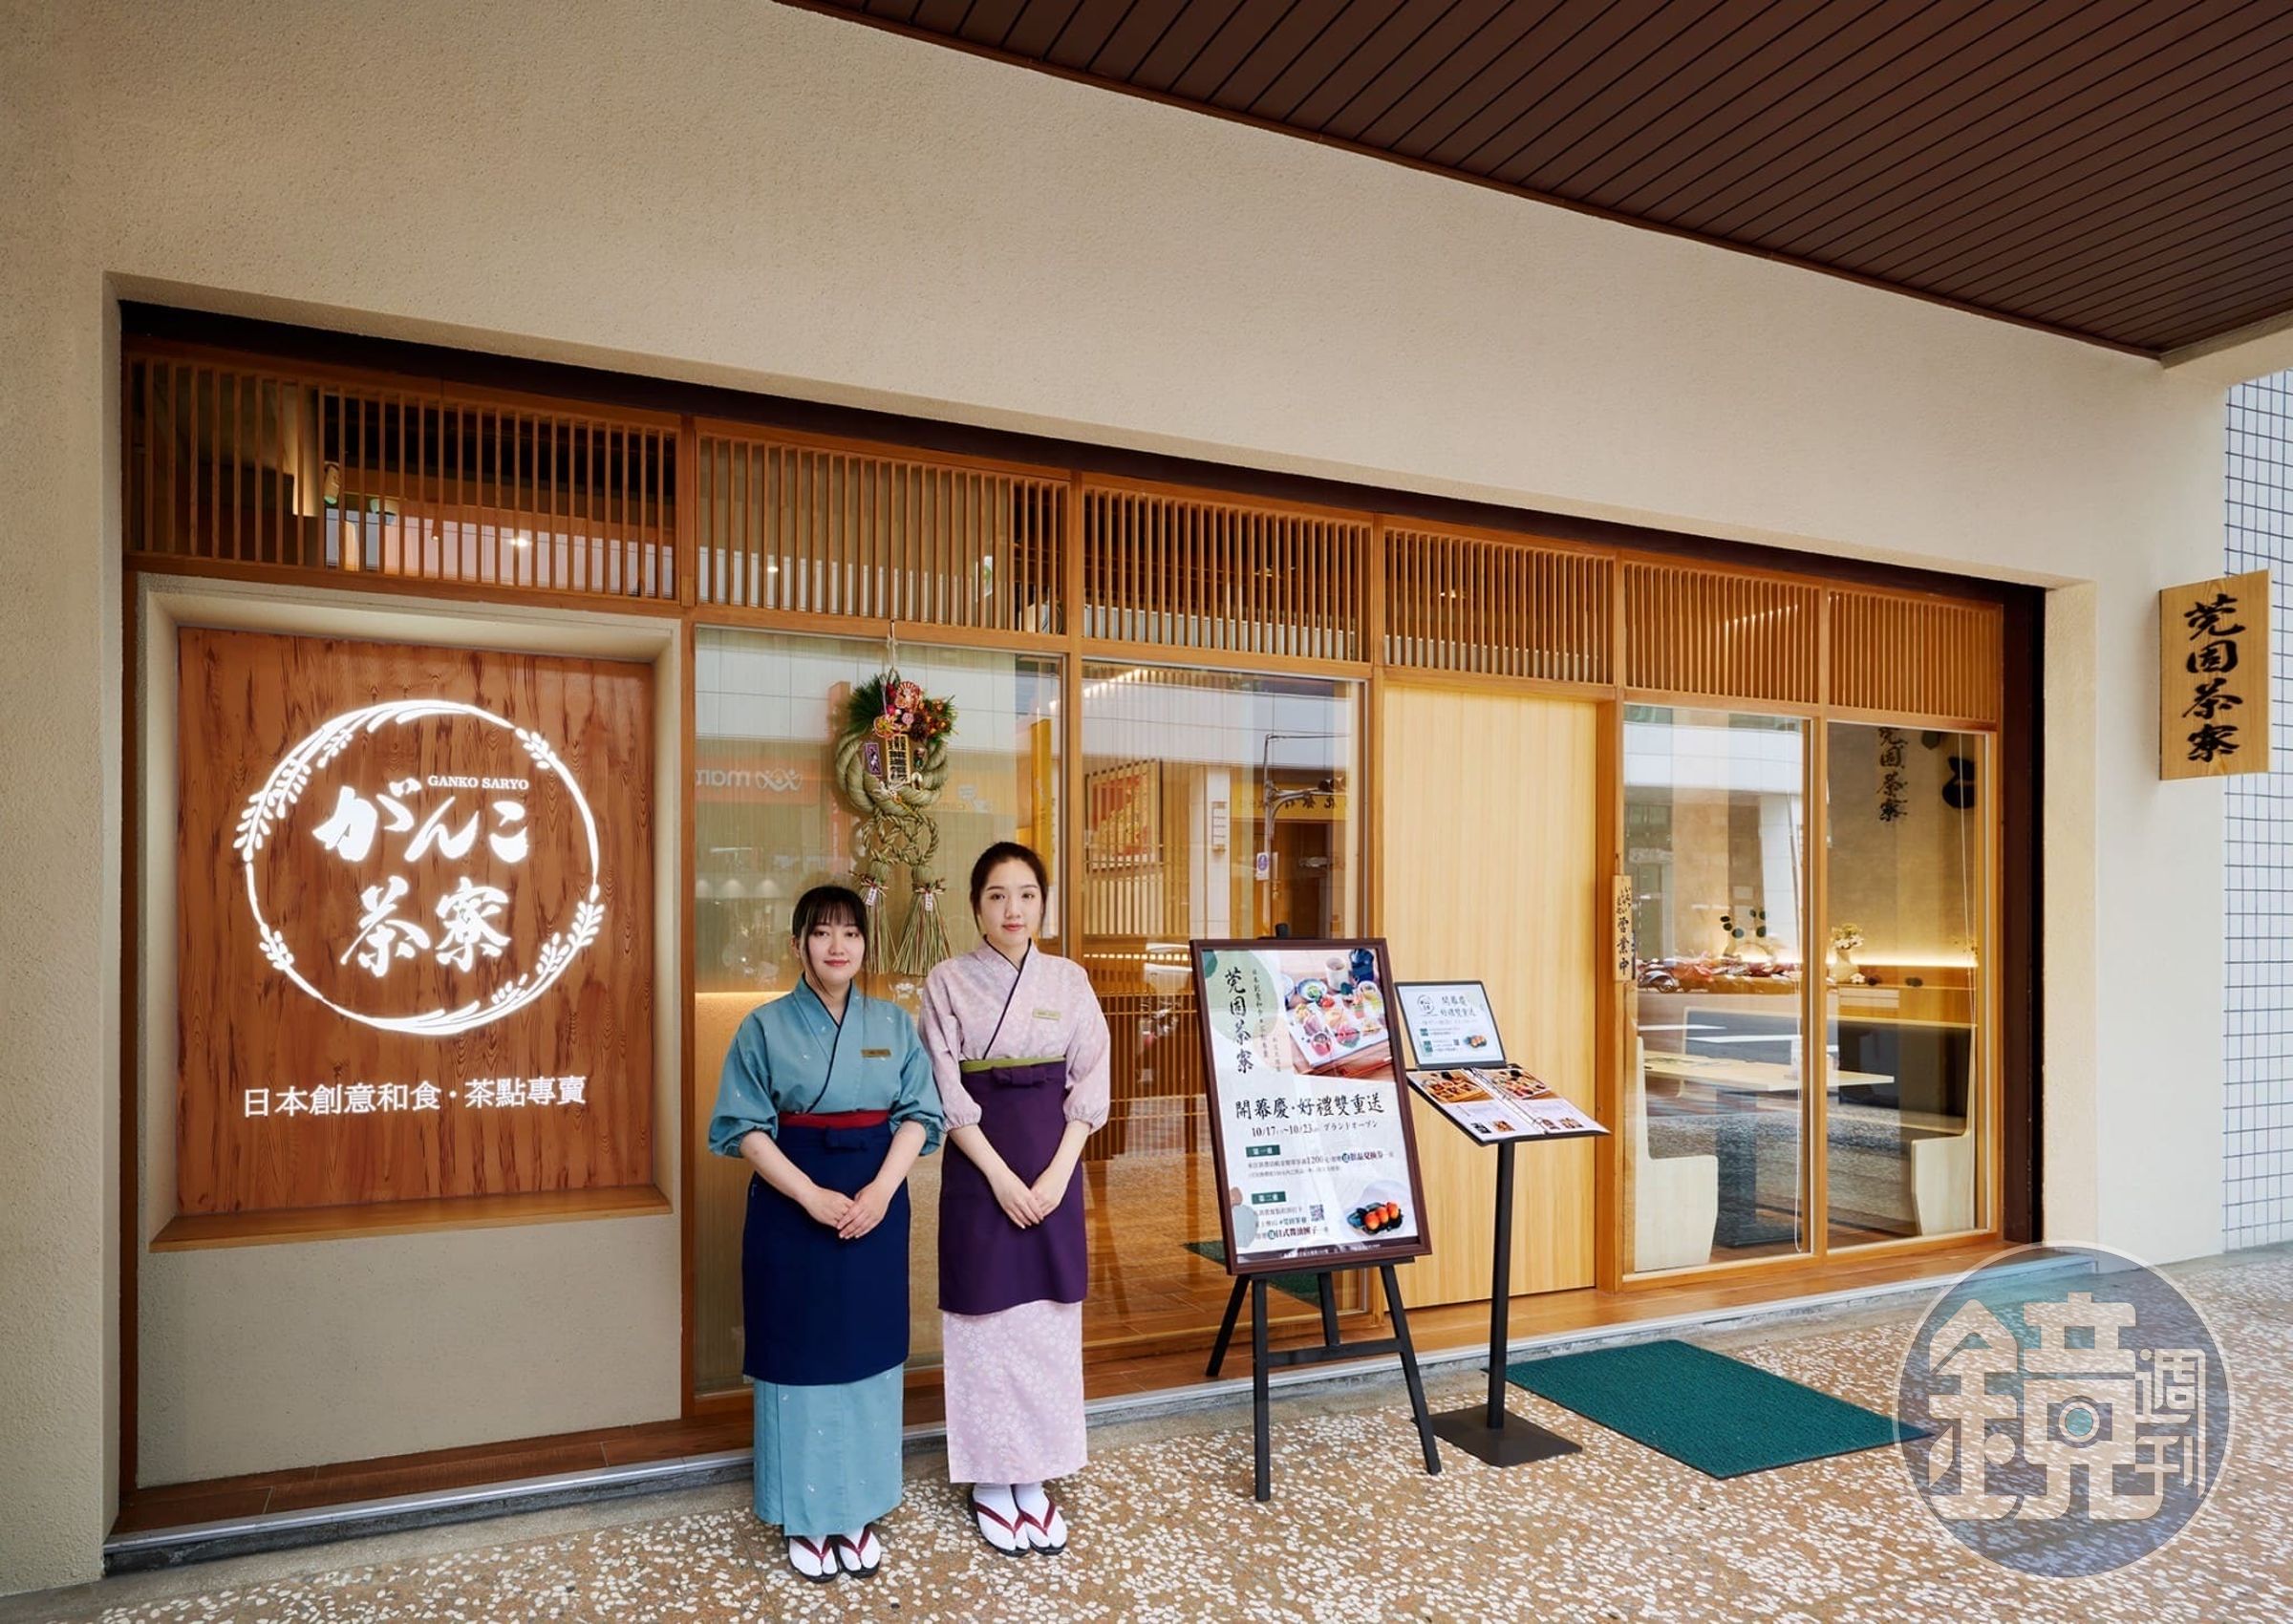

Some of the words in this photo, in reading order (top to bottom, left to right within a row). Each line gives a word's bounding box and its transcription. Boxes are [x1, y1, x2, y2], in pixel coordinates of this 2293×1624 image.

[312, 777, 528, 864] がんこ
[428, 775, 478, 789] GANKO
[482, 776, 529, 791] SARYO
[340, 875, 512, 978] 茶寮
